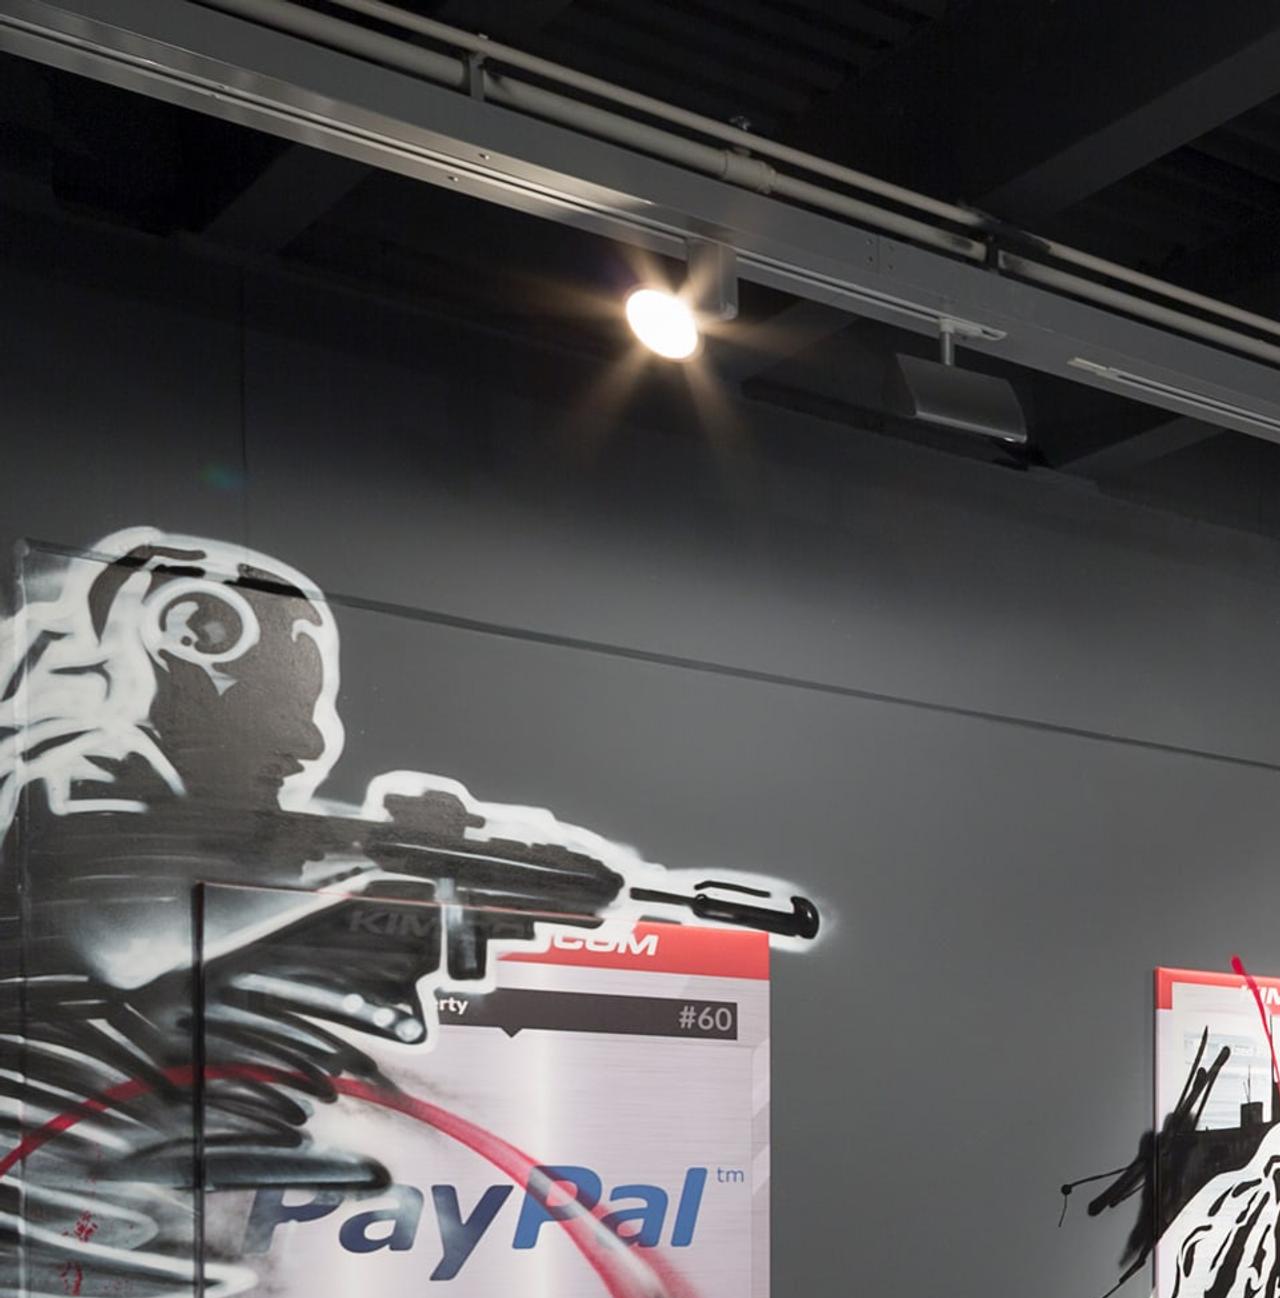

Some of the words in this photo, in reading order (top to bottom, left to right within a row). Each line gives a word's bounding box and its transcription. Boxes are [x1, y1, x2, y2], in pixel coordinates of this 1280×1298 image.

[439, 997, 469, 1016] rty
[679, 1005, 733, 1032] #60
[243, 1165, 708, 1281] PayPal
